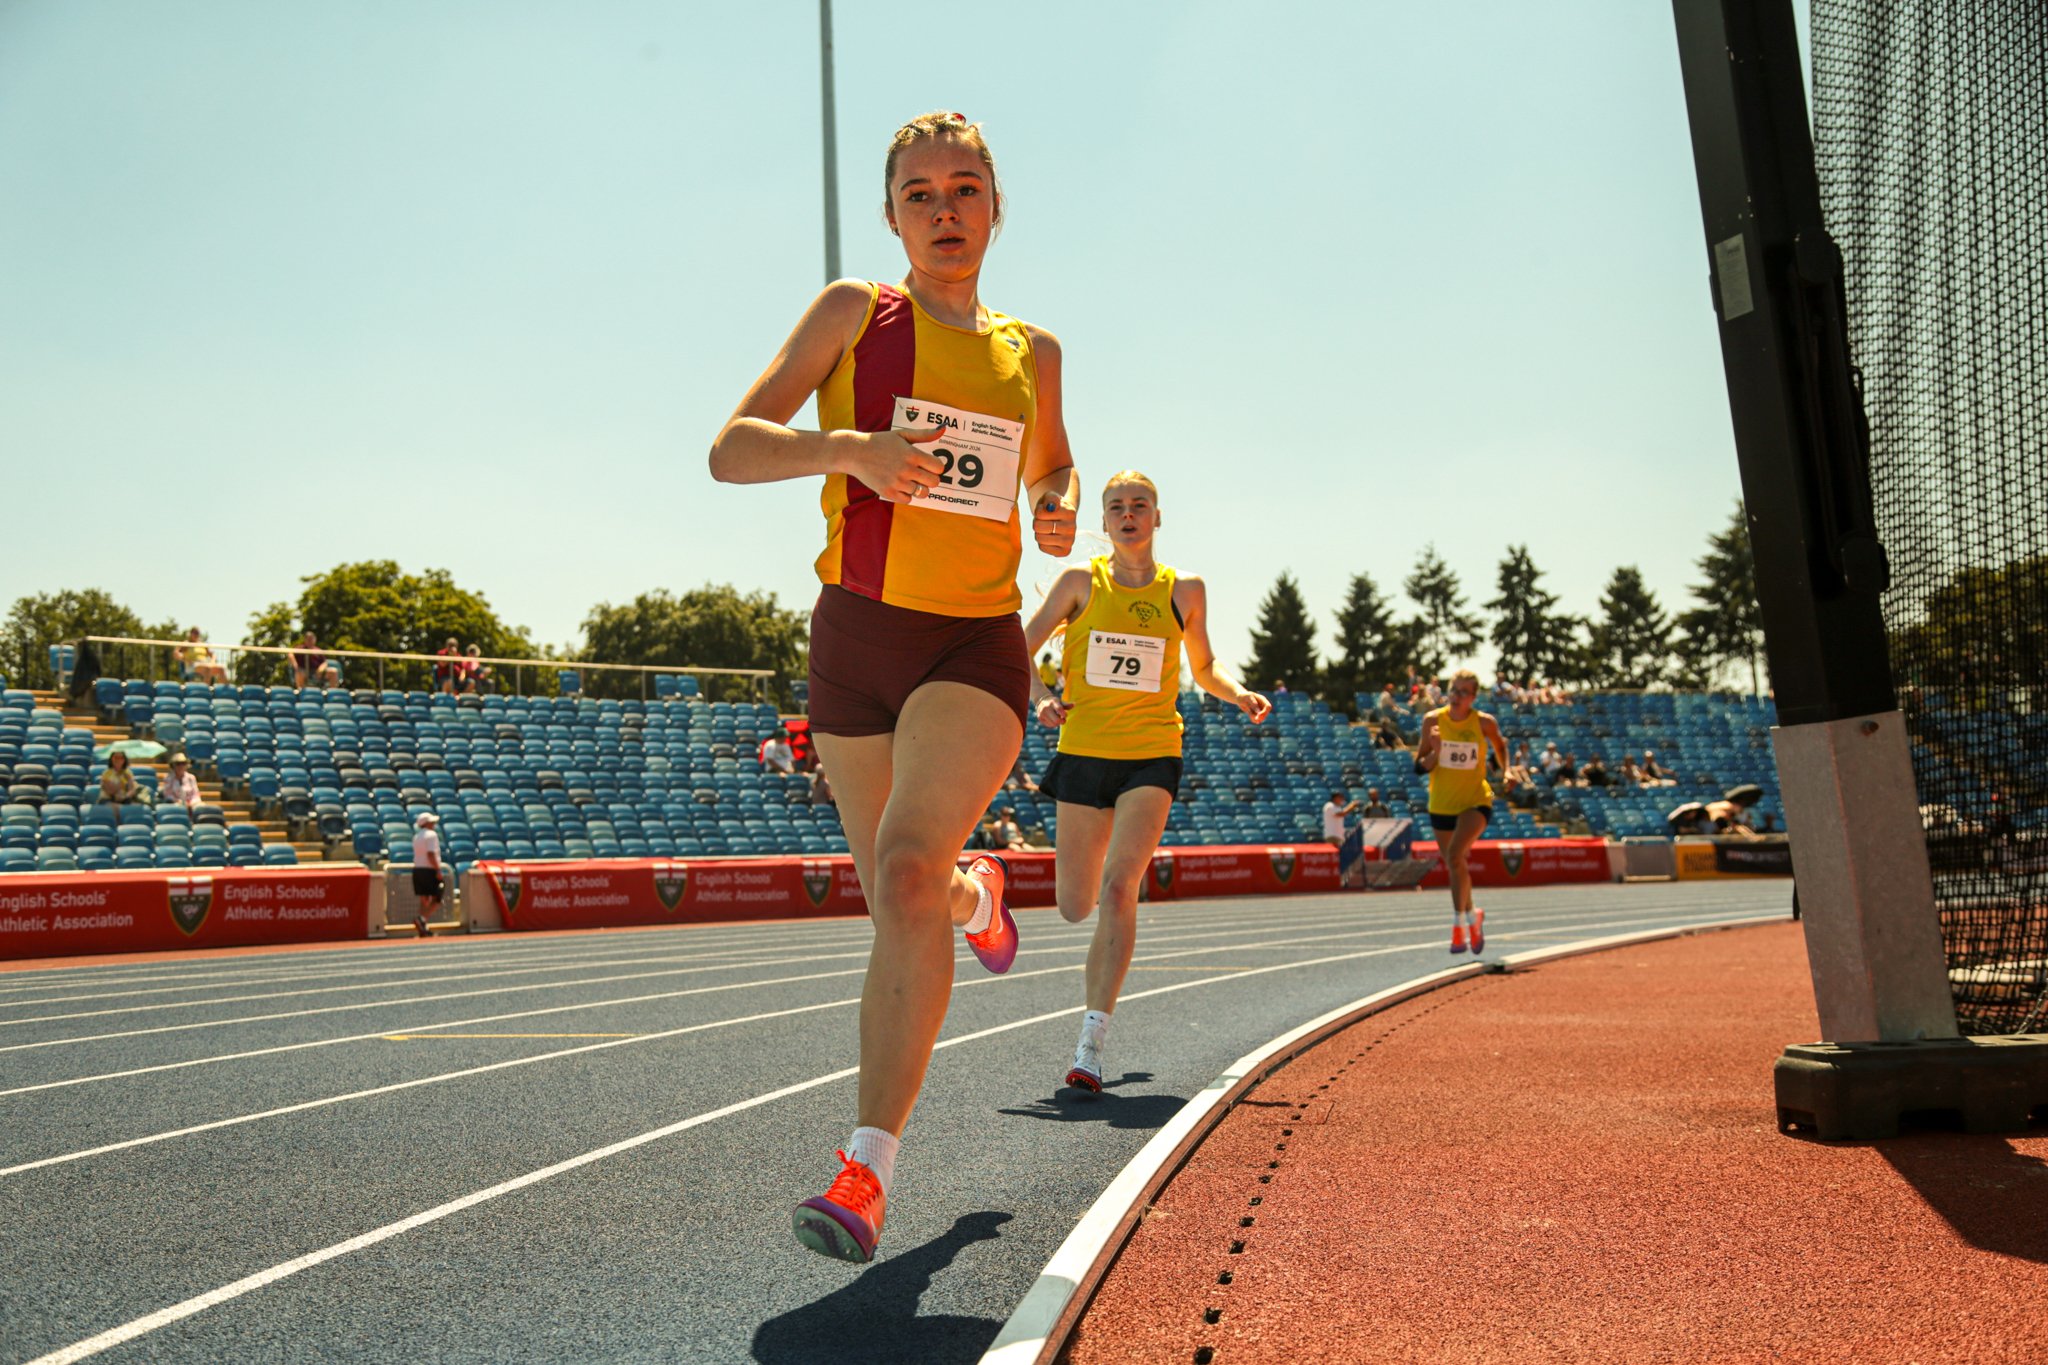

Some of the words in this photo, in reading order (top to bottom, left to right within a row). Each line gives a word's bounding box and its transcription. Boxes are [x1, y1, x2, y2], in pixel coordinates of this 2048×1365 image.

[927, 412, 958, 429] ESAA
[932, 448, 984, 488] 29
[1106, 637, 1127, 645] ESAA
[1110, 655, 1142, 676] 79
[1451, 752, 1467, 763] 80
[530, 877, 568, 893] English
[696, 872, 731, 887] English
[224, 884, 272, 902] English
[532, 895, 570, 908] Athletic
[573, 893, 630, 907] Association
[697, 889, 732, 902] Athletic
[735, 888, 789, 901] Association
[0, 892, 46, 913] nglish
[53, 912, 133, 930] Association
[224, 904, 273, 921] Athletic
[277, 904, 349, 920] Association
